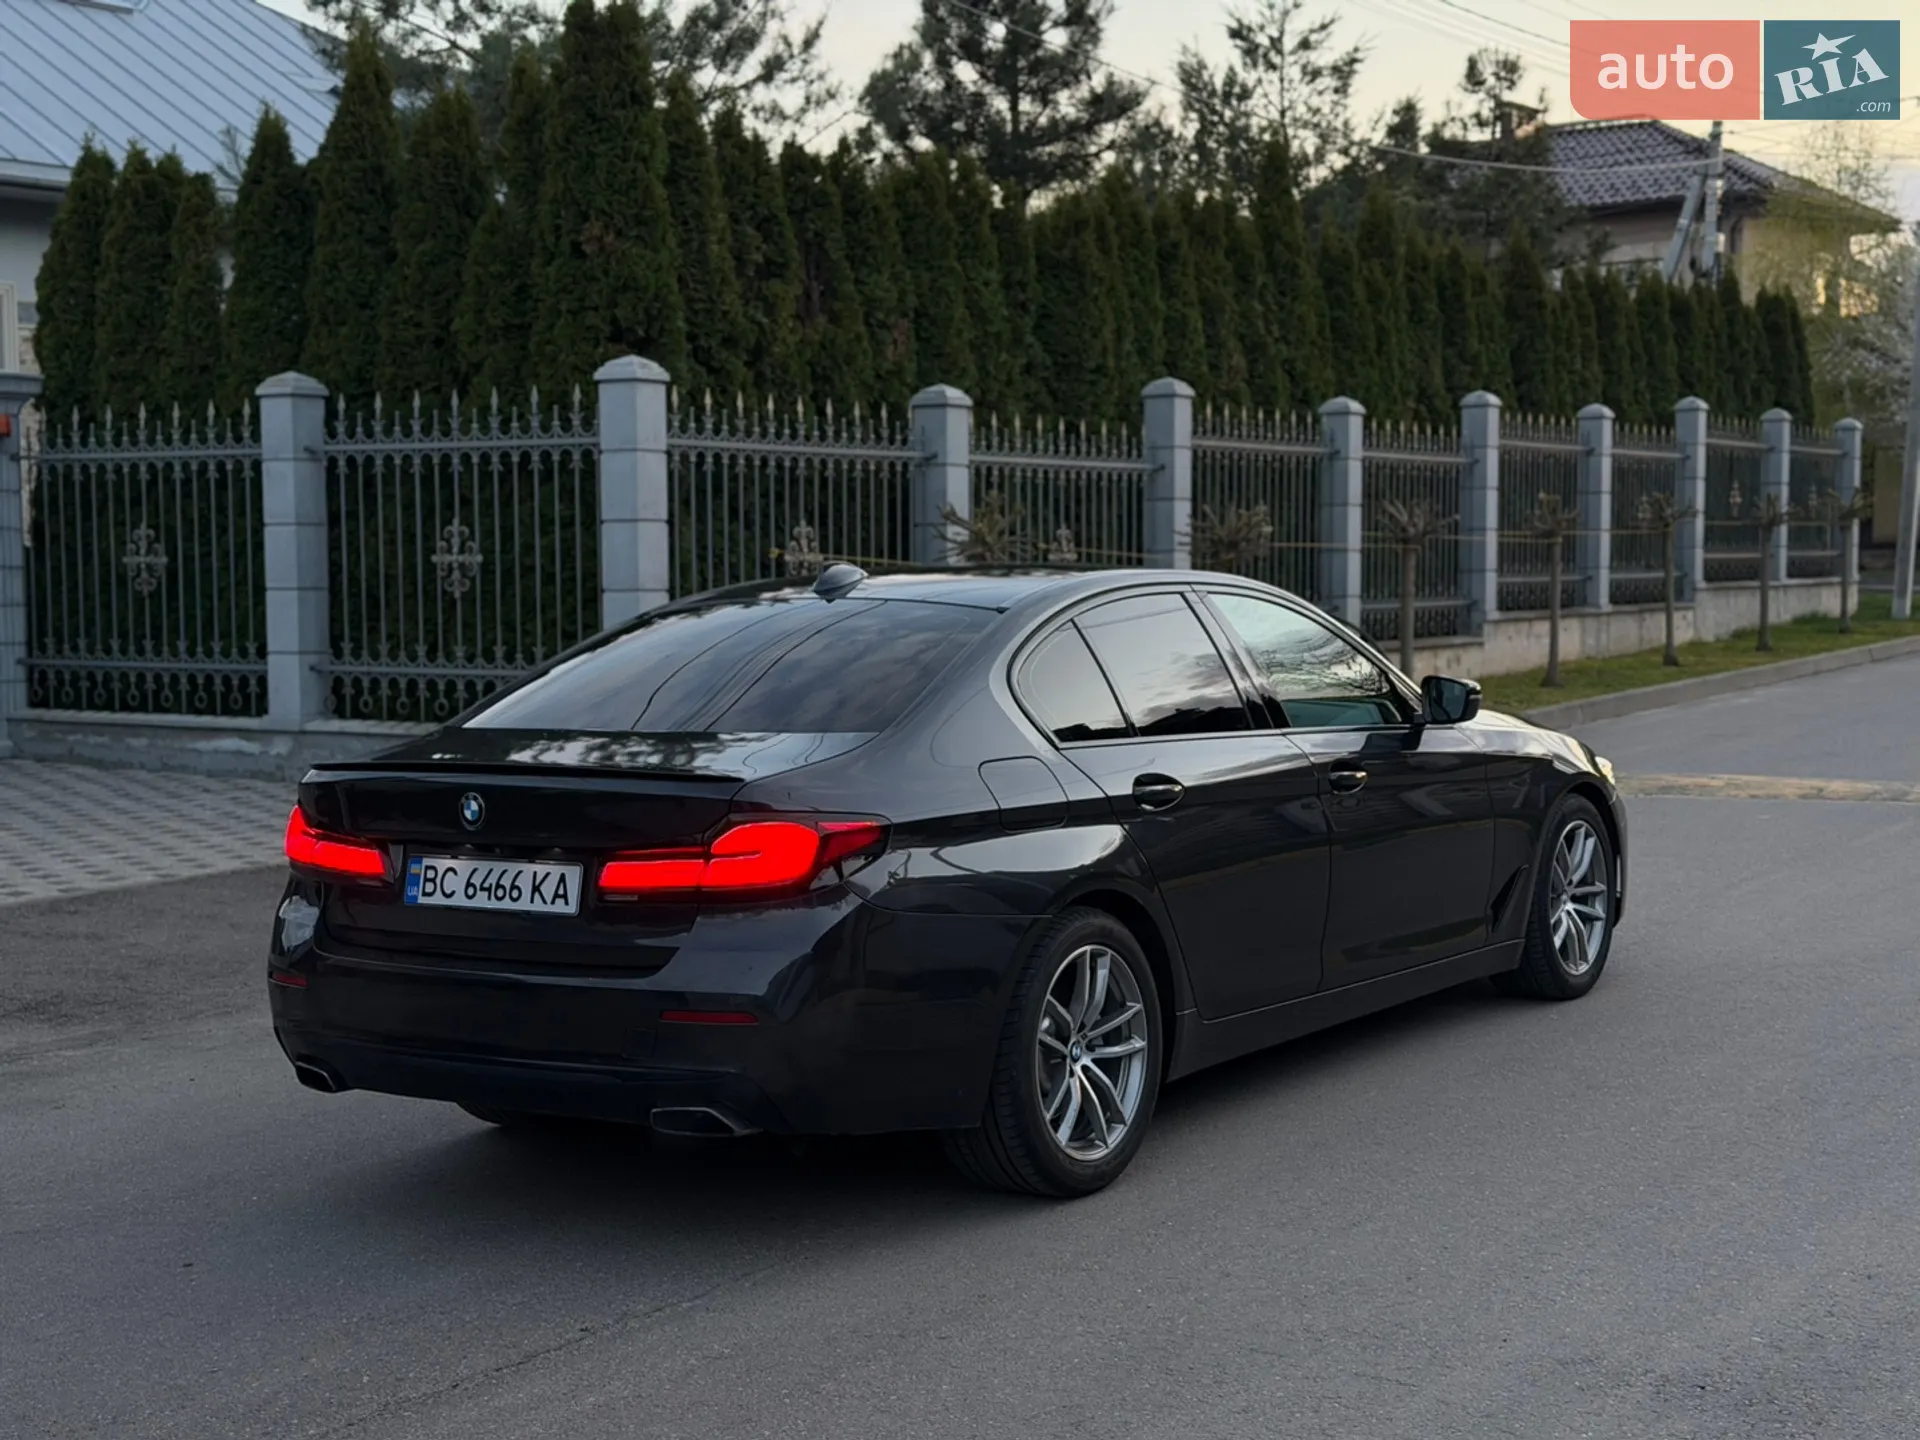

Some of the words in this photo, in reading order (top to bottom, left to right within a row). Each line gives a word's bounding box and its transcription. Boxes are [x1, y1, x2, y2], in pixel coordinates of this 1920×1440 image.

[407, 886, 419, 897] UA
[421, 865, 458, 899] BC
[464, 867, 524, 903] 6466
[530, 870, 569, 906] KA
